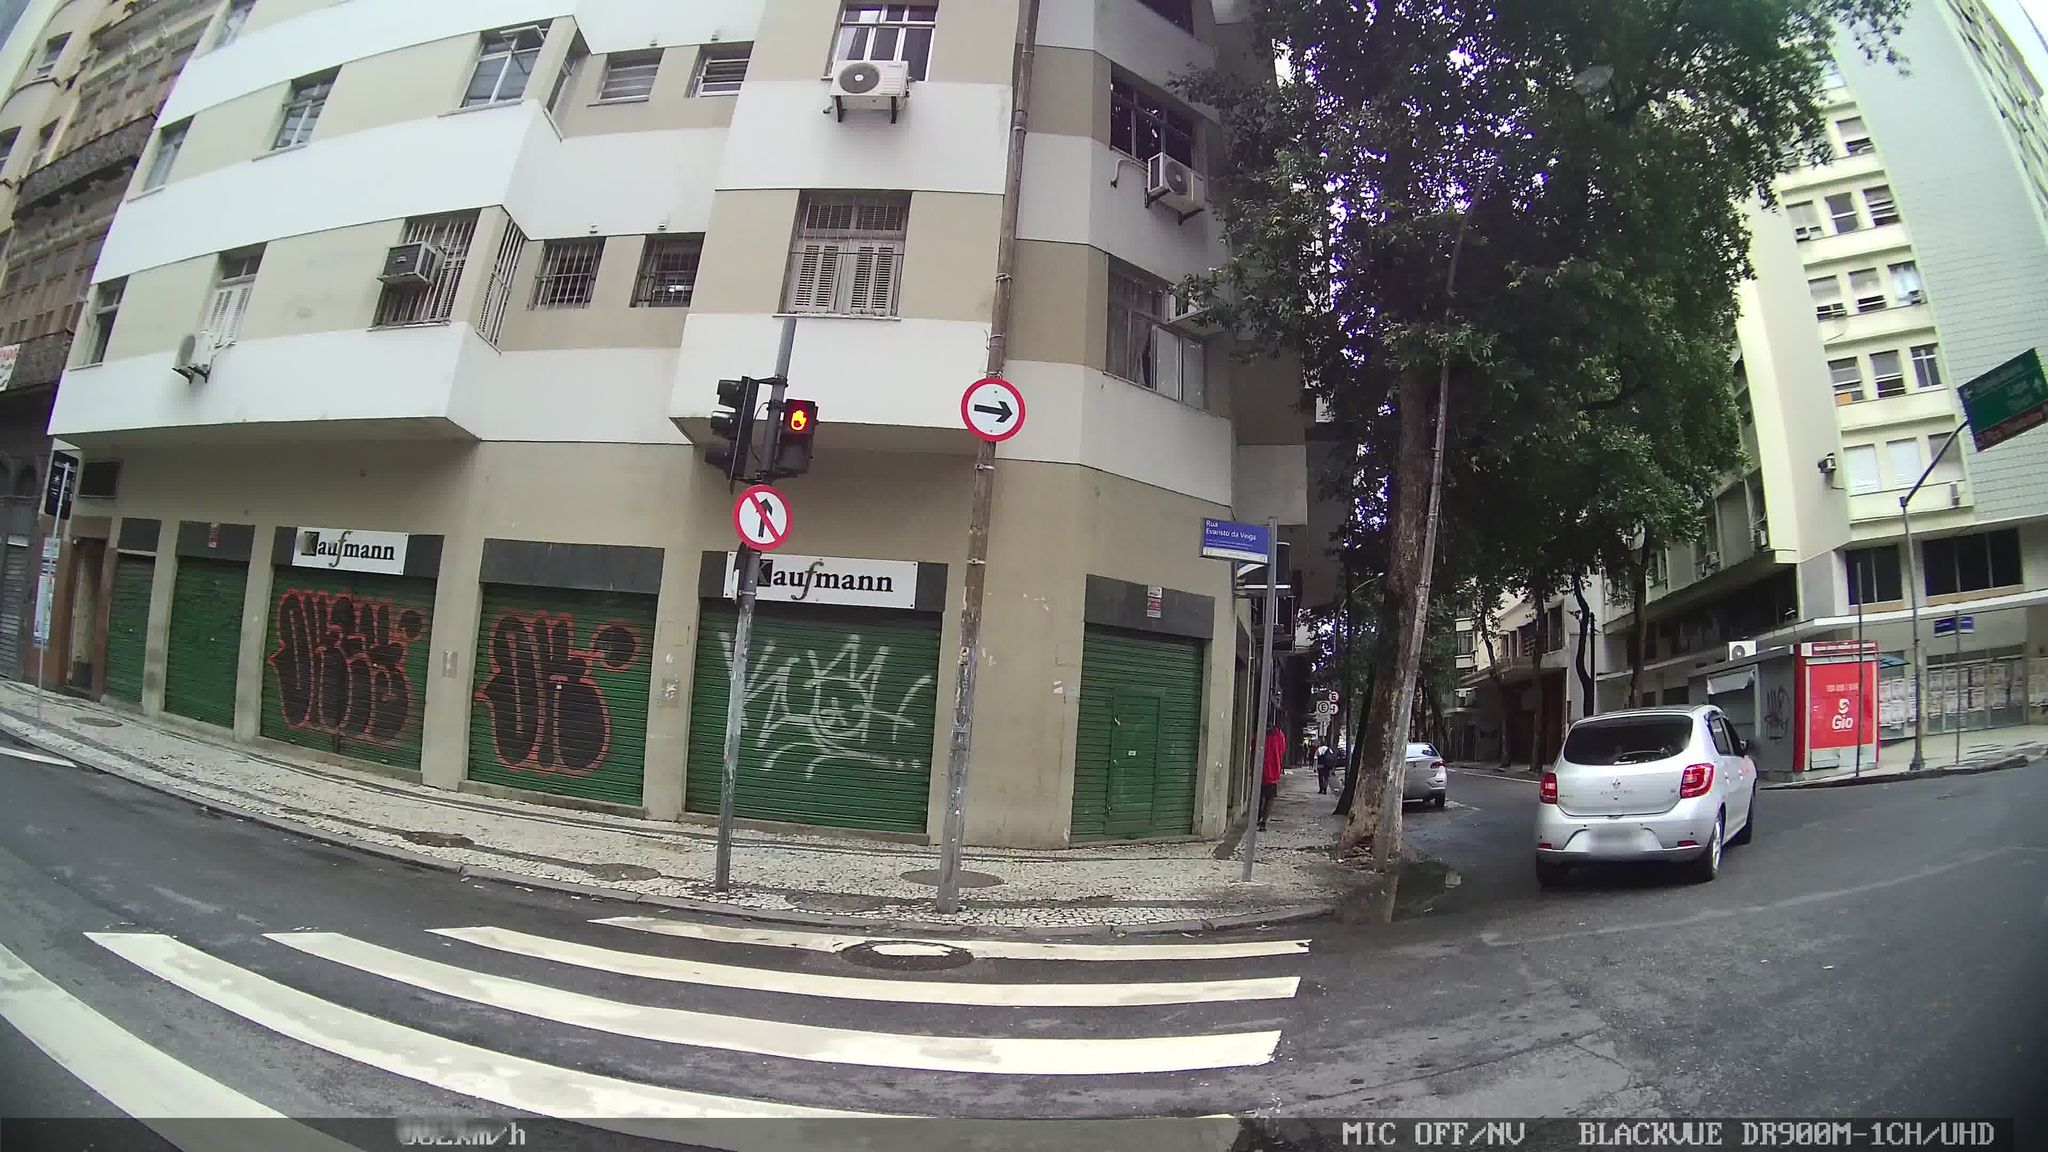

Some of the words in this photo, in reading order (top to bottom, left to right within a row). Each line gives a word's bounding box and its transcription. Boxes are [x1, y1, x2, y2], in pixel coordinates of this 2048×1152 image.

[1206, 527, 1230, 536] Evaristo
[1240, 532, 1256, 541] Veiga
[301, 530, 395, 567] aufmann
[1832, 714, 1853, 730] Gio
